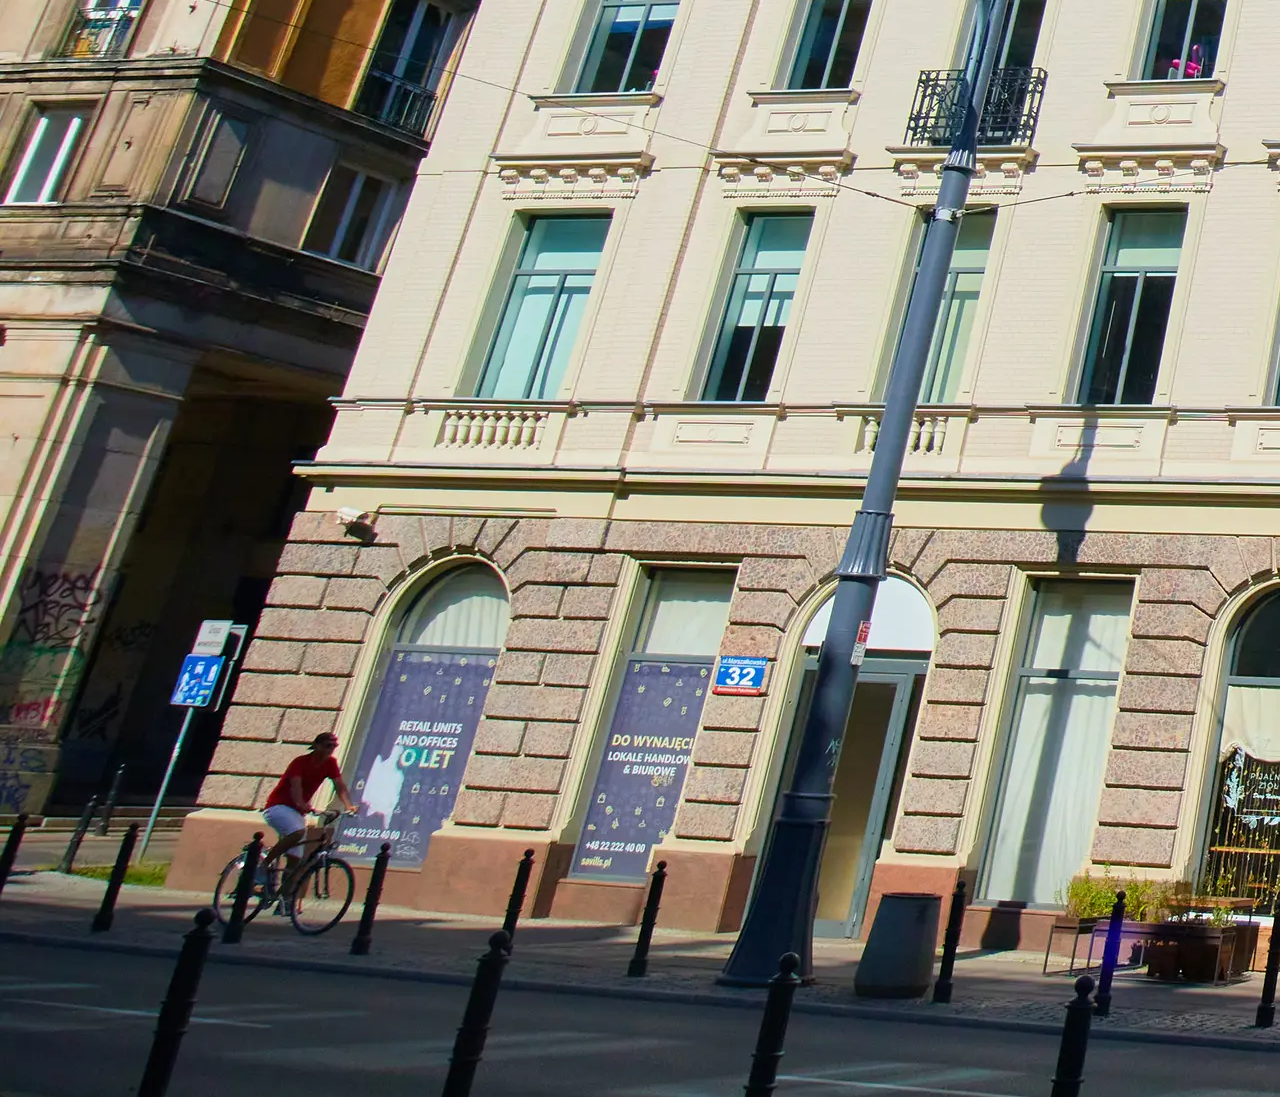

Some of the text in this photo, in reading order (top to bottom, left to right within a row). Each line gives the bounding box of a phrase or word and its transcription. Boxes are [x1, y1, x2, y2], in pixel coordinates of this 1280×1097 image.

[725, 667, 756, 686] 32
[399, 720, 463, 734] RETAIL UNITS
[394, 735, 458, 748] AND OFFICES
[611, 734, 693, 751] DO WYNAJĘCI
[401, 749, 455, 769] O LET
[607, 751, 689, 765] LOKALE HANDLOW
[623, 764, 677, 776] & BIUROWE
[586, 841, 646, 852] +48 22 222 40 00
[581, 857, 612, 868] savills.pl
